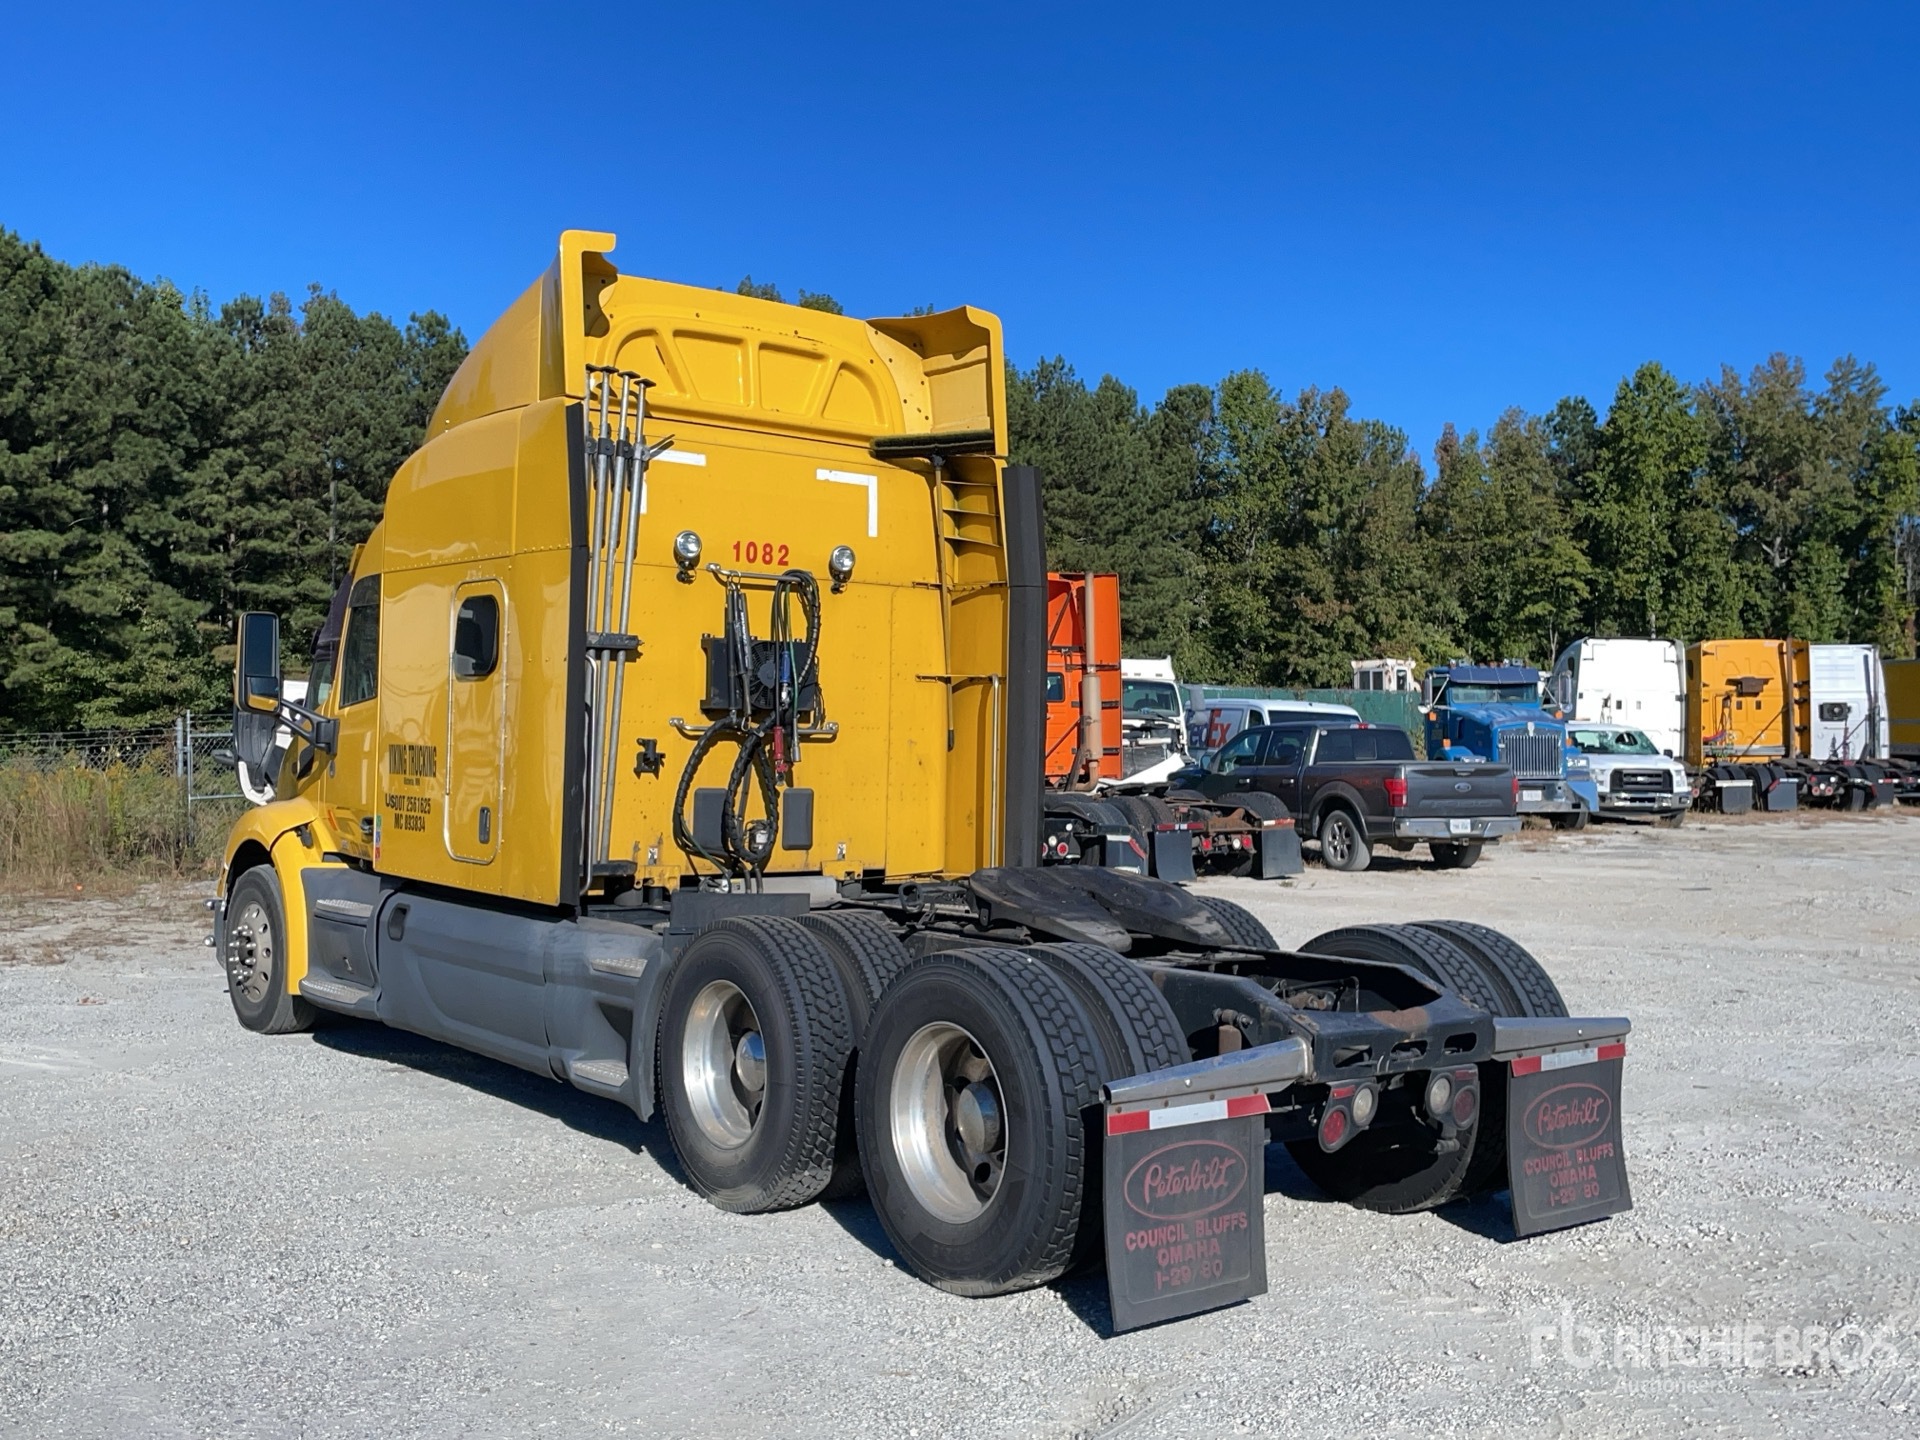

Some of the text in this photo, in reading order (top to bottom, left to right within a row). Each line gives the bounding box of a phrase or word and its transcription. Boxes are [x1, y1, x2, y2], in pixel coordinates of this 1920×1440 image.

[733, 541, 789, 566] 1082
[1187, 708, 1231, 747] edEx
[388, 744, 437, 778] VIKING TRUCKING
[385, 793, 405, 811] USDOT
[394, 813, 404, 830] MC
[1537, 1097, 1604, 1136] Peterbilt
[1525, 1142, 1614, 1175] COUNCIL BLUFFS
[1143, 1156, 1236, 1204] Peterbilt
[1550, 1164, 1597, 1188] OMAHA
[1125, 1211, 1248, 1251] COUNCIL BLUFFS
[1157, 1238, 1220, 1266] OMAHA
